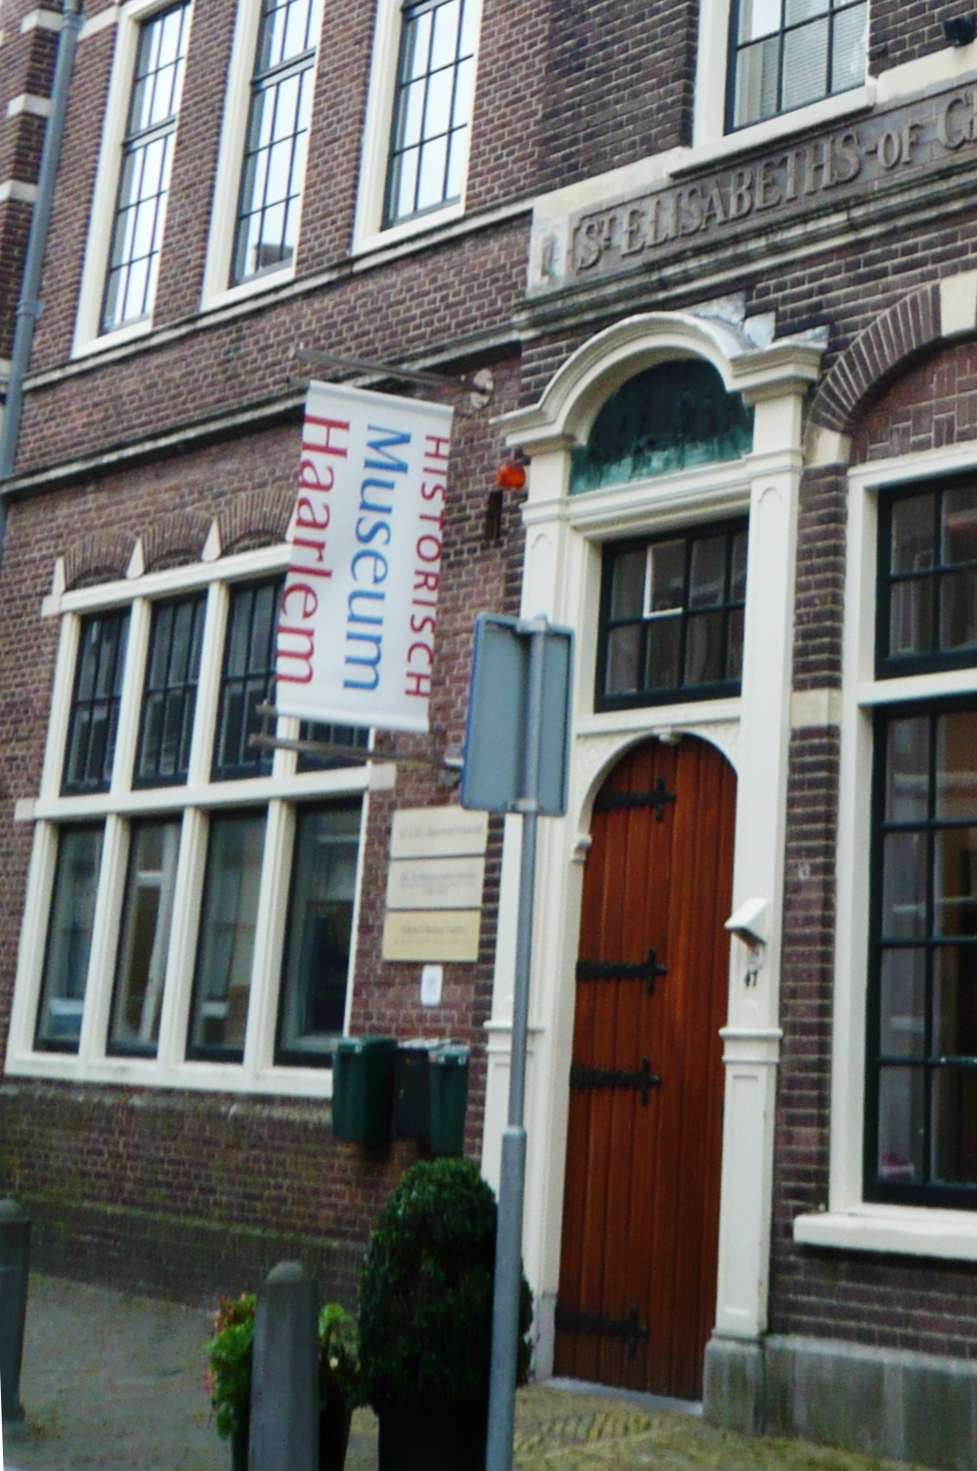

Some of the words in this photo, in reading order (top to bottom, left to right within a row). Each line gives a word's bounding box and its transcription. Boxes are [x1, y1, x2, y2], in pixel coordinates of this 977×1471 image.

[276, 414, 351, 685] Haarlem
[342, 423, 413, 693] Museum
[404, 433, 450, 698] HISTORISCH
